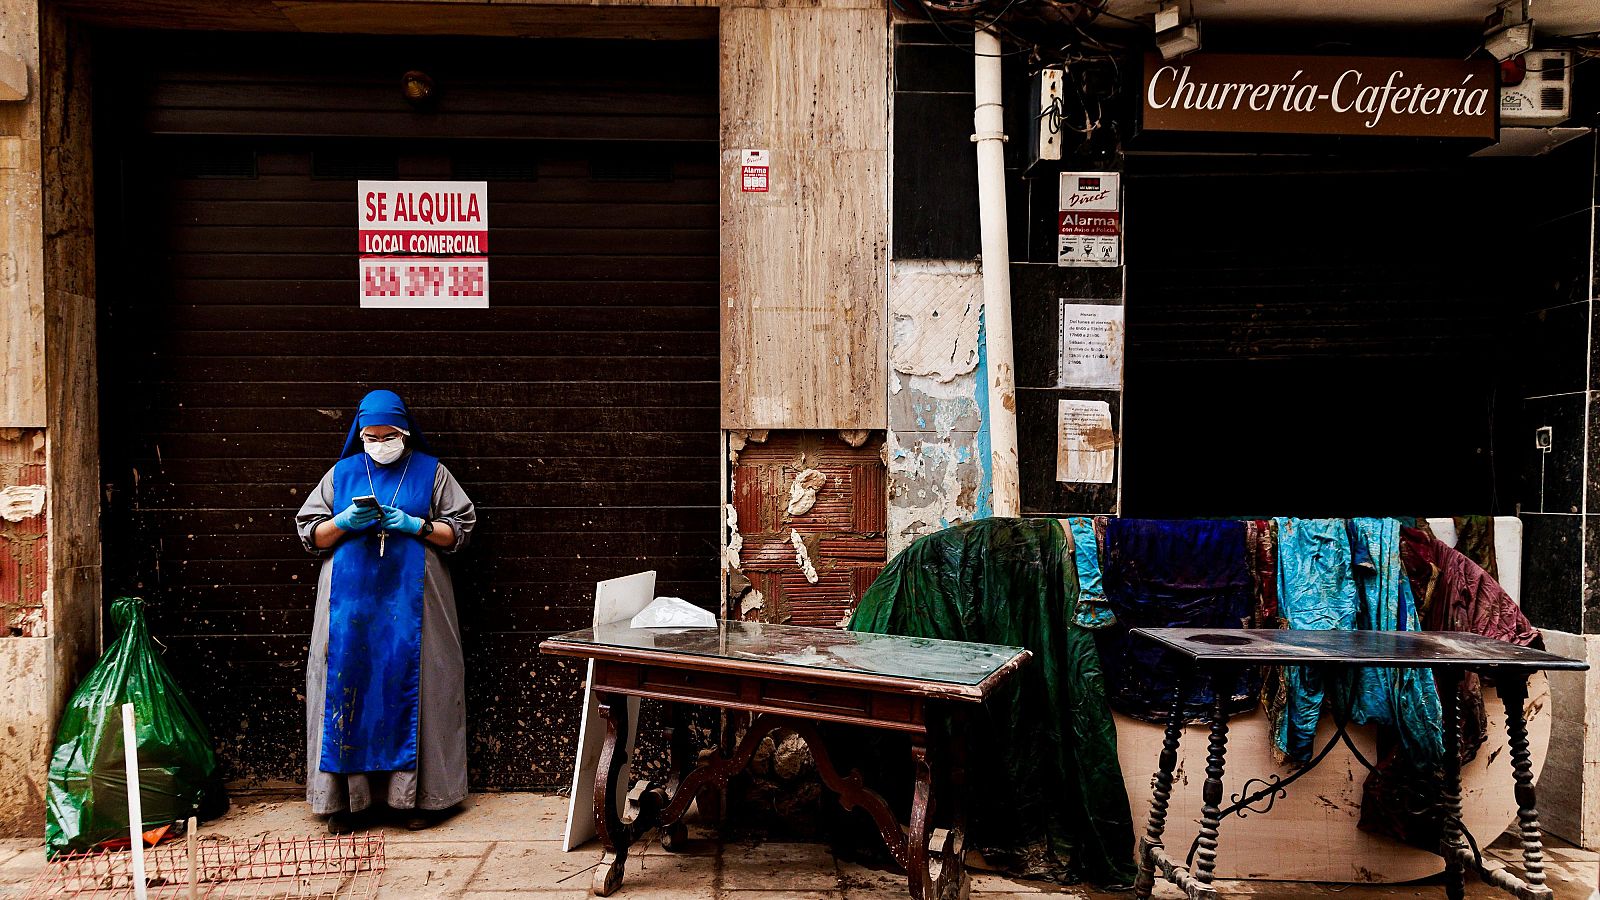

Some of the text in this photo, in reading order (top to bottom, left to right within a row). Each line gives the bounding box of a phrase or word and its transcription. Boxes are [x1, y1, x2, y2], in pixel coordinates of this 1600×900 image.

[1147, 65, 1489, 128] Churrería-Cafetería
[365, 191, 481, 225] SE ALQUILA
[1068, 189, 1110, 207] Direct
[1062, 214, 1116, 226] Alarma
[365, 234, 482, 254] LOCAL COMERCIAL
